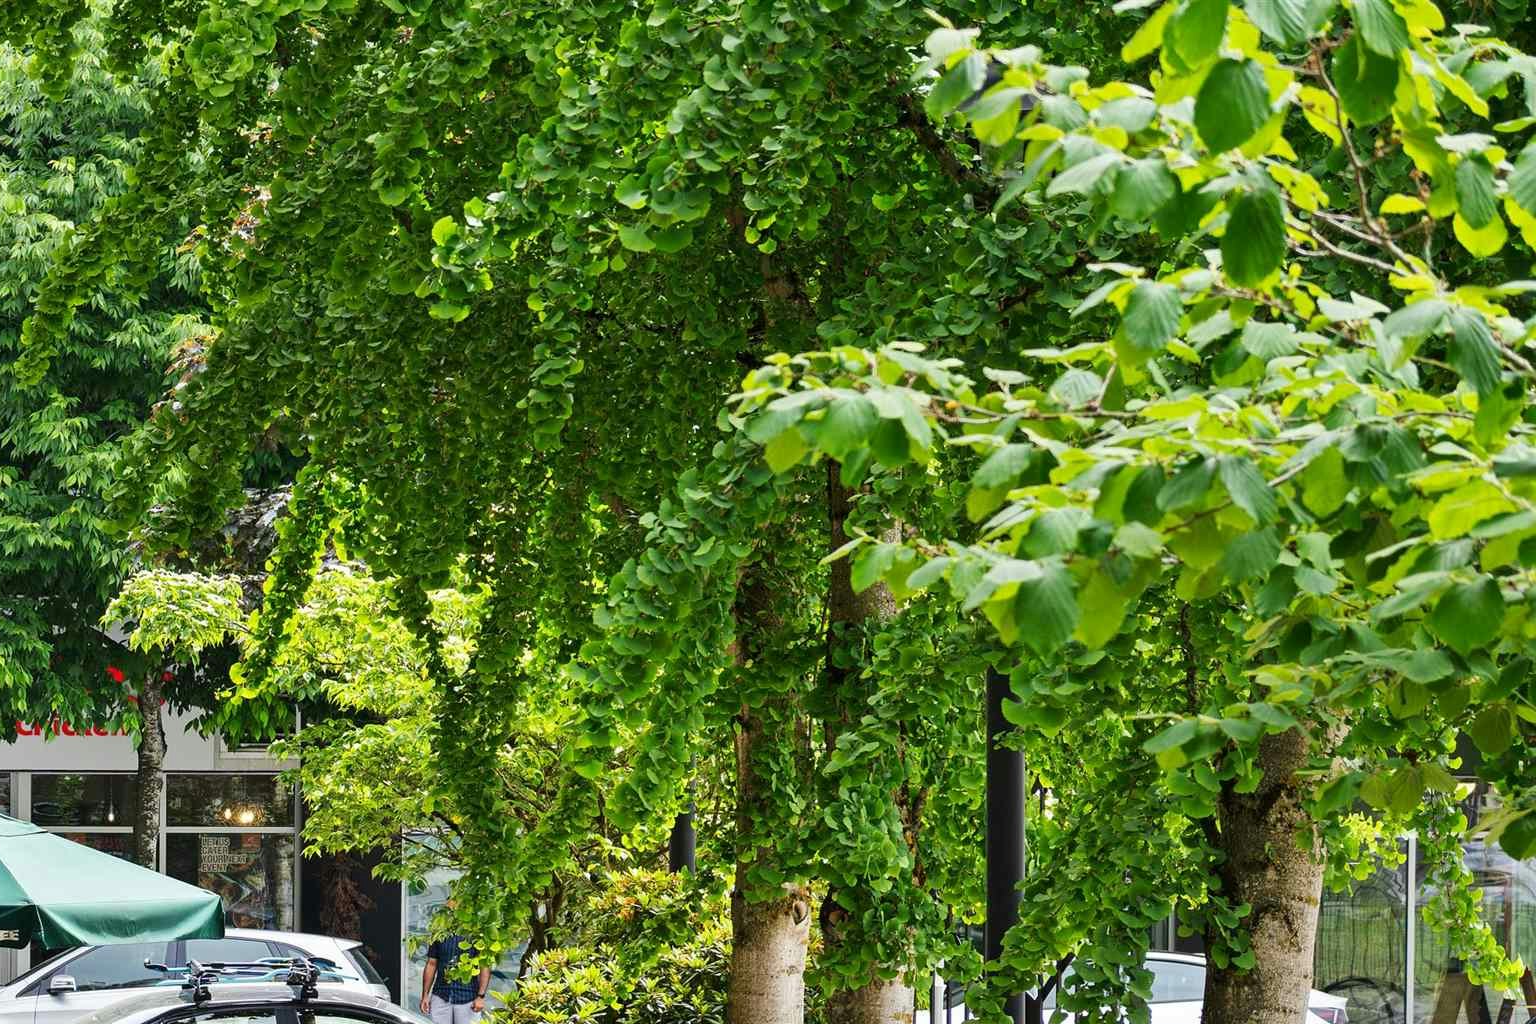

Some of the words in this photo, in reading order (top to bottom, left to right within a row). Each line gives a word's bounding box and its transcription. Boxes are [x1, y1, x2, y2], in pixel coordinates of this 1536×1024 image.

[201, 837, 218, 846] LET
[219, 837, 231, 846] US
[201, 846, 229, 855] CATER
[201, 855, 225, 864] YOUR
[226, 855, 247, 864] NEXT
[201, 863, 229, 872] EVENT
